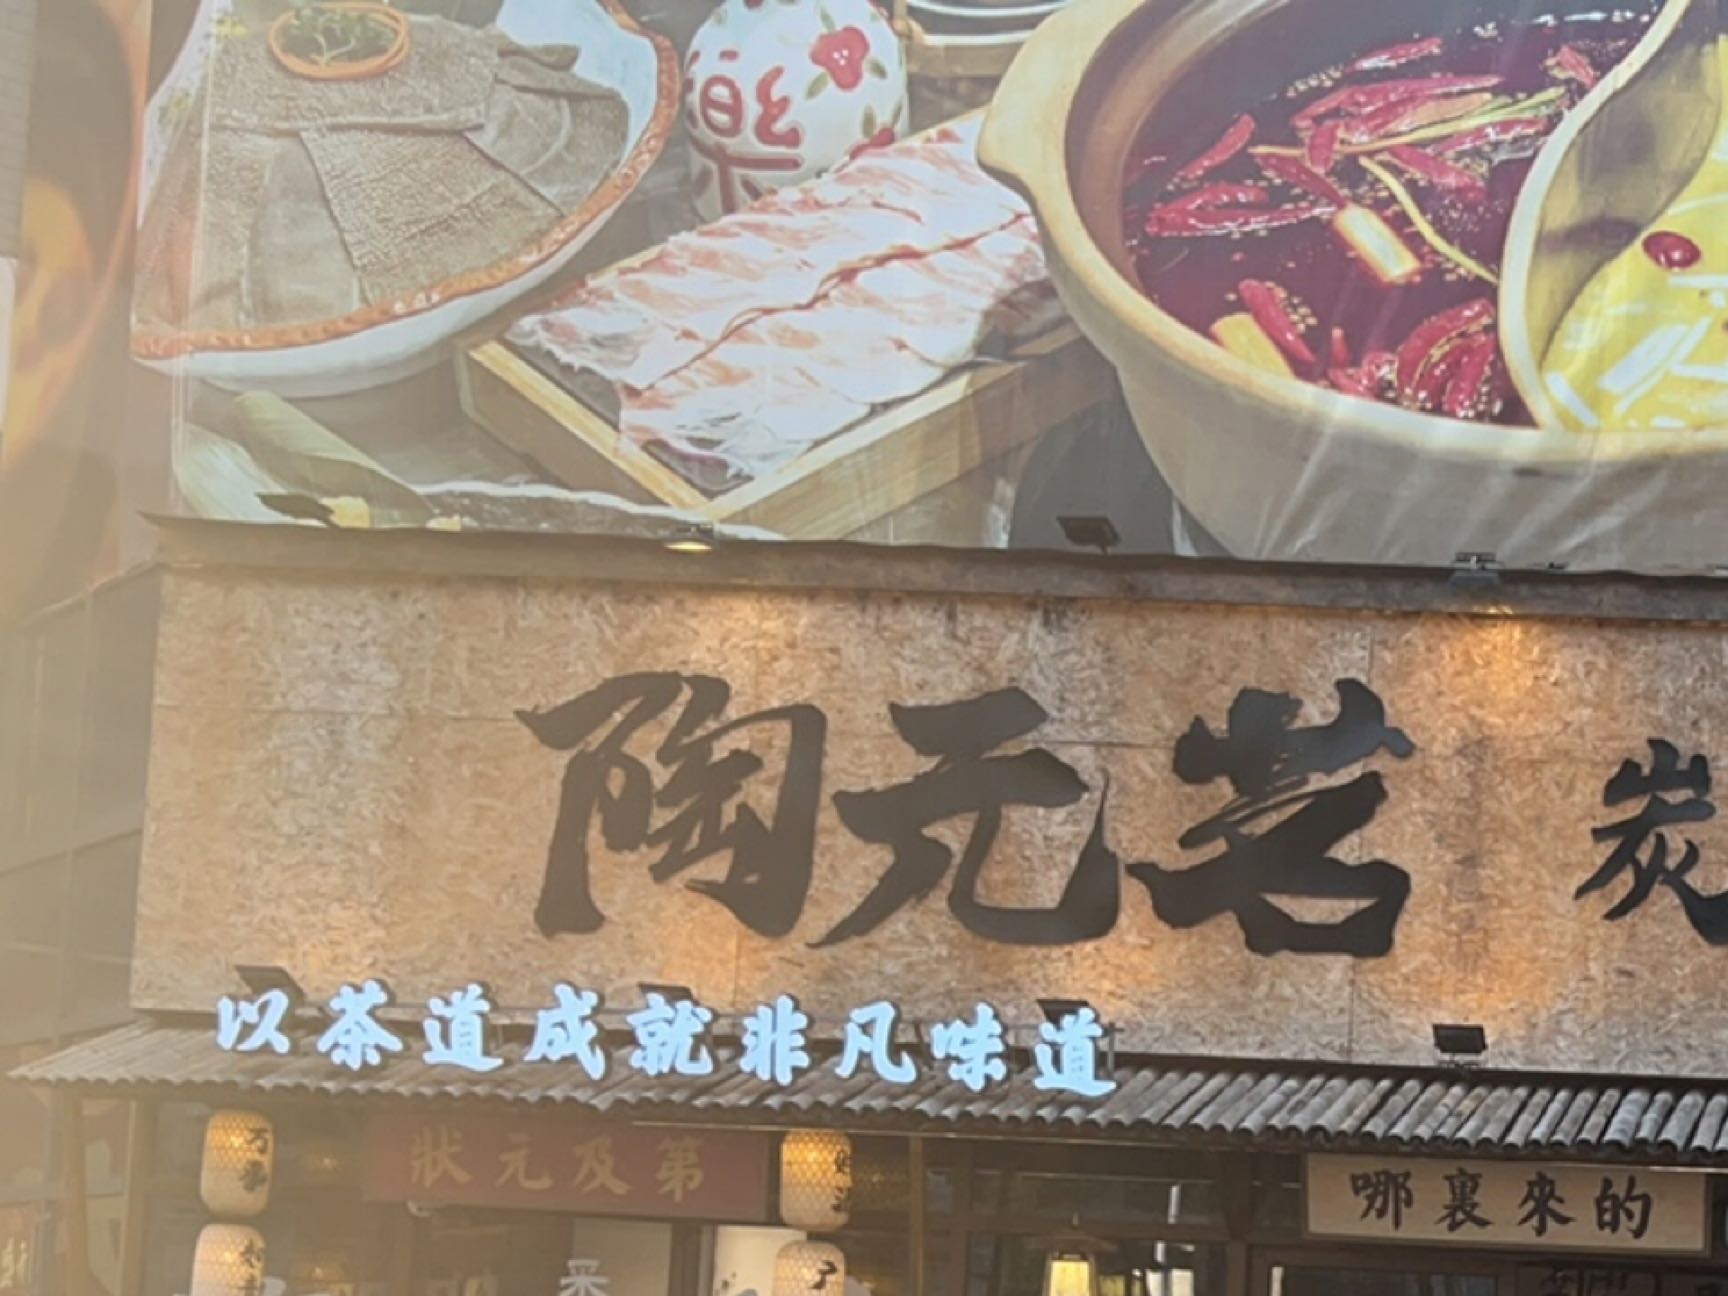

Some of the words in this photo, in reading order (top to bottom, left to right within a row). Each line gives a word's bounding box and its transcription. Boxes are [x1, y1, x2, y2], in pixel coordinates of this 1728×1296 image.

[513, 670, 1416, 957] 陶元岩
[213, 980, 1118, 1098] 以茶道成就非凡味道
[1350, 1167, 1653, 1240] 哪裏來的
